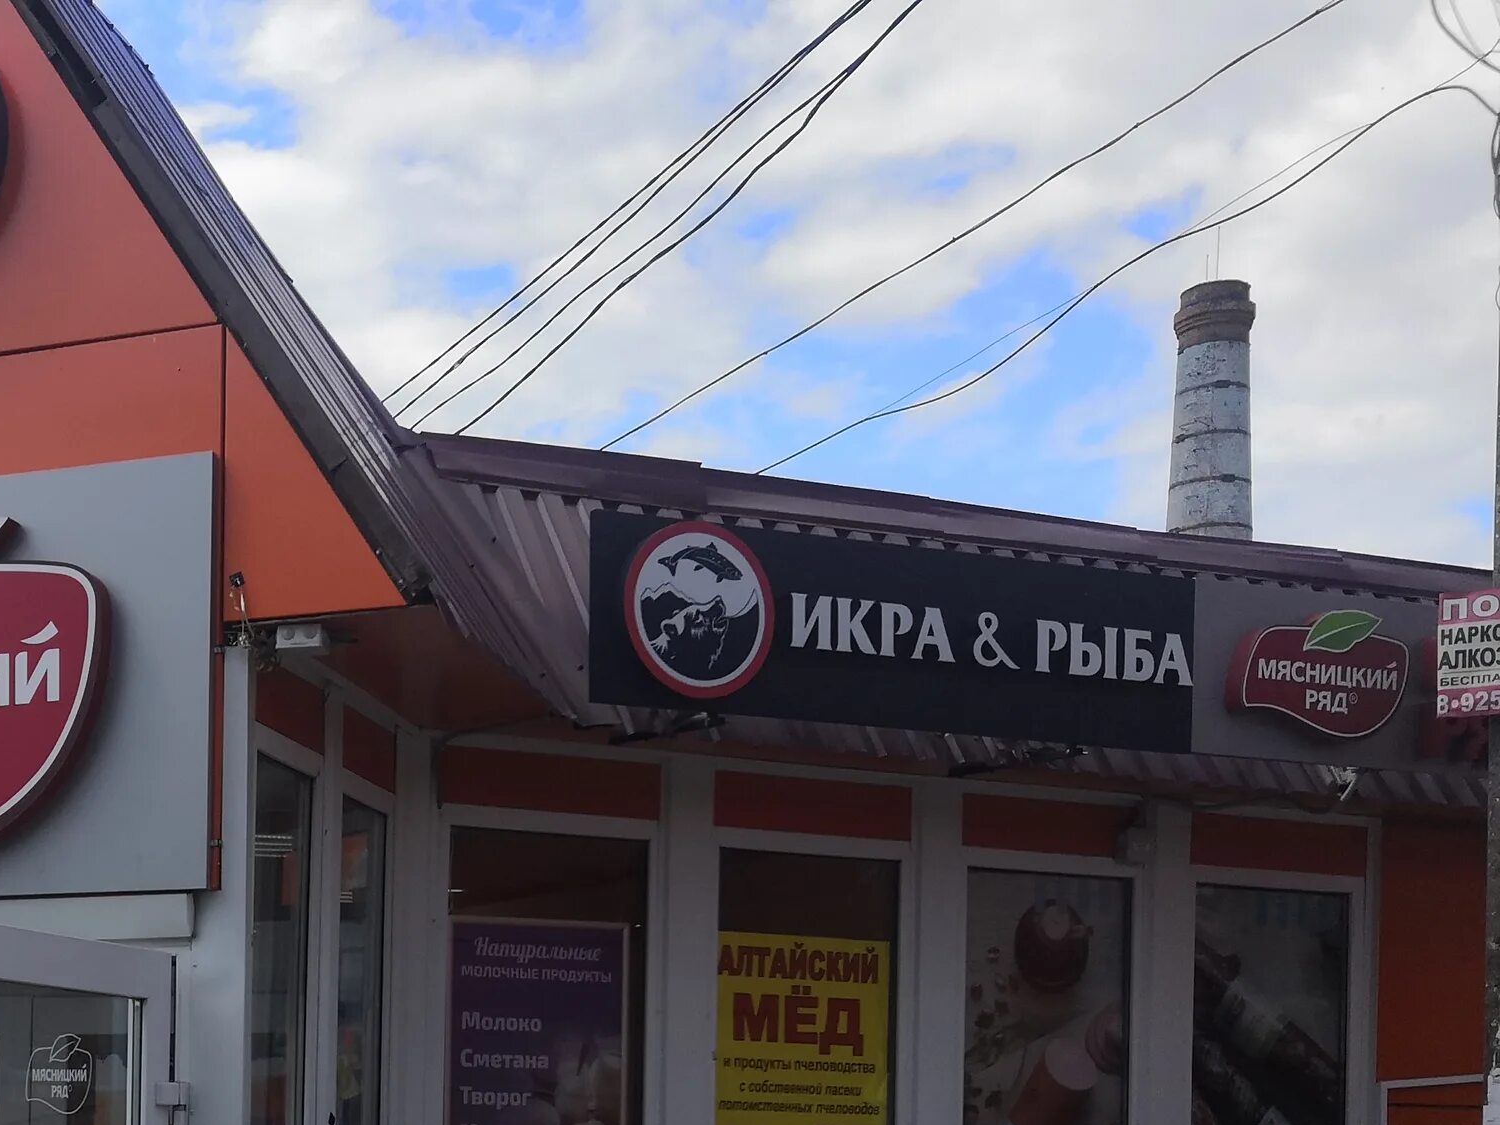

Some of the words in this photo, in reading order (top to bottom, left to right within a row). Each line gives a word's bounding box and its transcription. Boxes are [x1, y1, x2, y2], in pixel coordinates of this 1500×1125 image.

[790, 592, 956, 663] ИКРА
[972, 611, 1021, 669] &
[1034, 618, 1194, 686] РЫБА
[1257, 658, 1398, 691] МЯСНИЦКИЙ
[474, 936, 602, 964] Натуральные
[717, 941, 879, 984] АЛТАЙСКИЙ
[461, 964, 539, 980] МОЛОЧНЫЕ
[541, 968, 612, 983] ПРОДУКТЫ
[461, 1011, 542, 1032] Молоко
[733, 985, 864, 1056] МЁД
[459, 1048, 549, 1069] Сметана
[733, 1057, 791, 1073] продукты
[794, 1059, 876, 1074] пчеловодства
[31, 1064, 87, 1082] МЯСНИЦКИЙ
[459, 1086, 532, 1110] Творог
[748, 1080, 822, 1095] собственной
[825, 1084, 862, 1096] пасеки
[816, 1101, 880, 1115] пчеловодов
